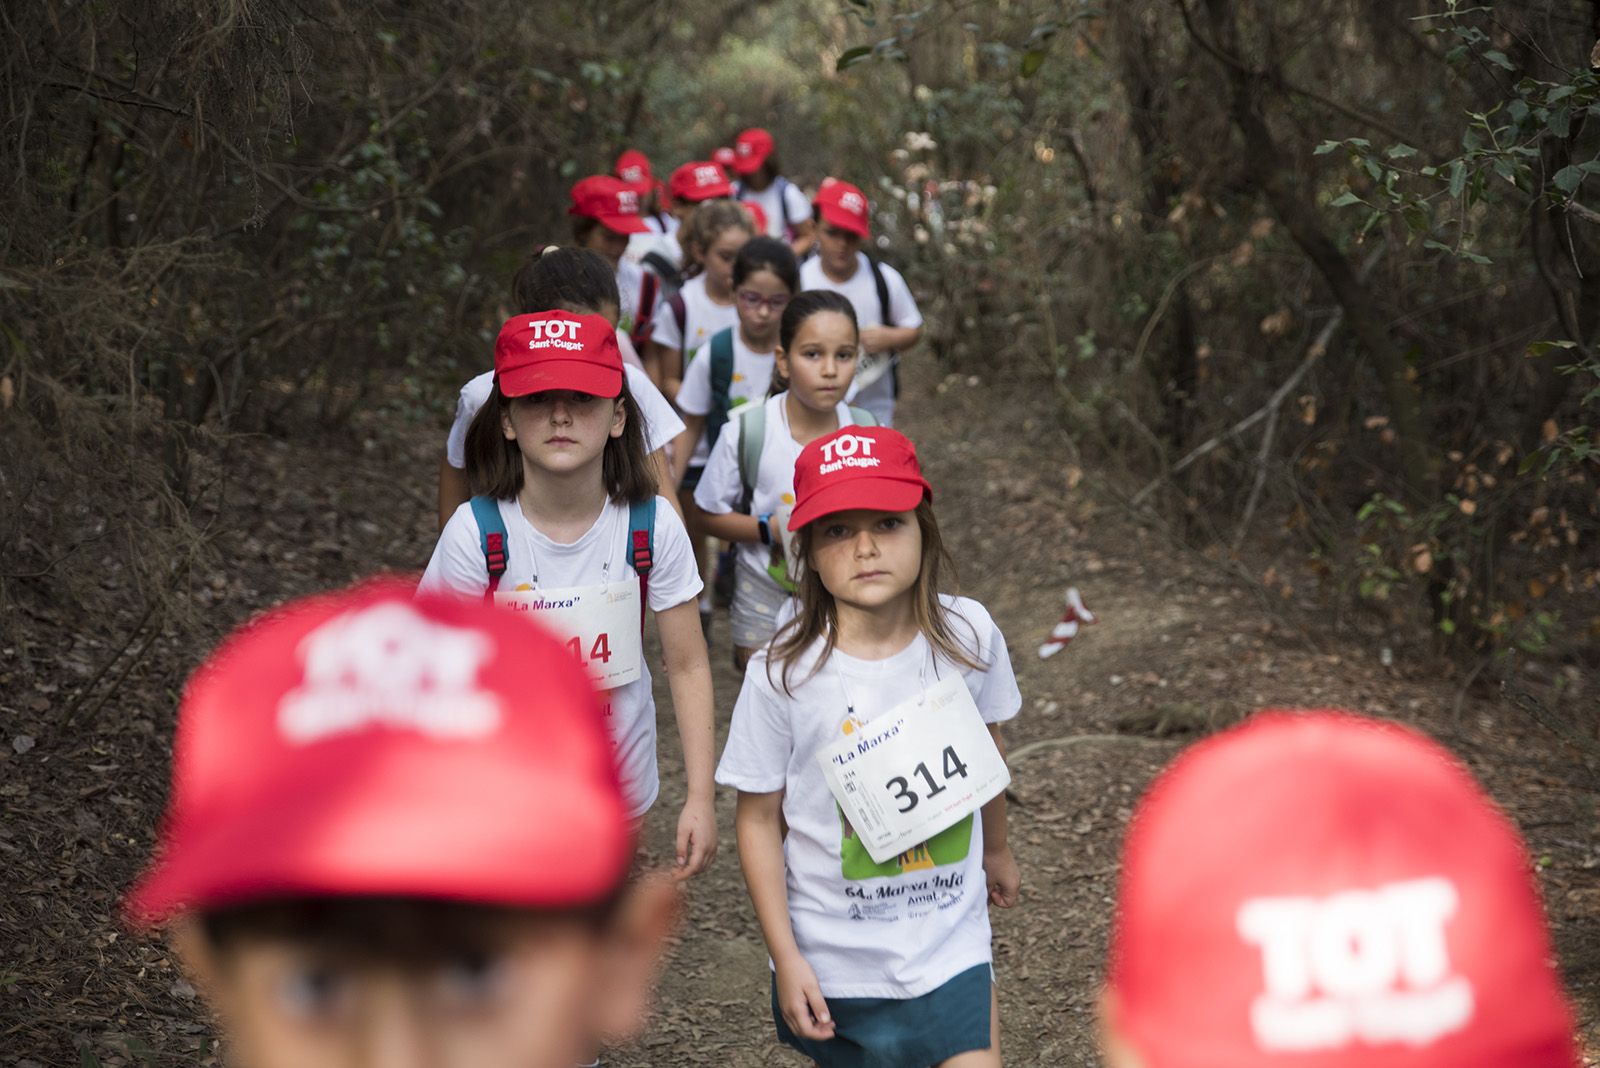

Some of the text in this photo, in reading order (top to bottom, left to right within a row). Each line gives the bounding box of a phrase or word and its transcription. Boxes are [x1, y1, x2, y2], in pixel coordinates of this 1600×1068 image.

[528, 319, 582, 340] TOT
[528, 338, 550, 350] Sant
[820, 433, 877, 463] TOT
[819, 458, 844, 476] Sant
[565, 632, 612, 668] 14
[885, 744, 968, 815] 314
